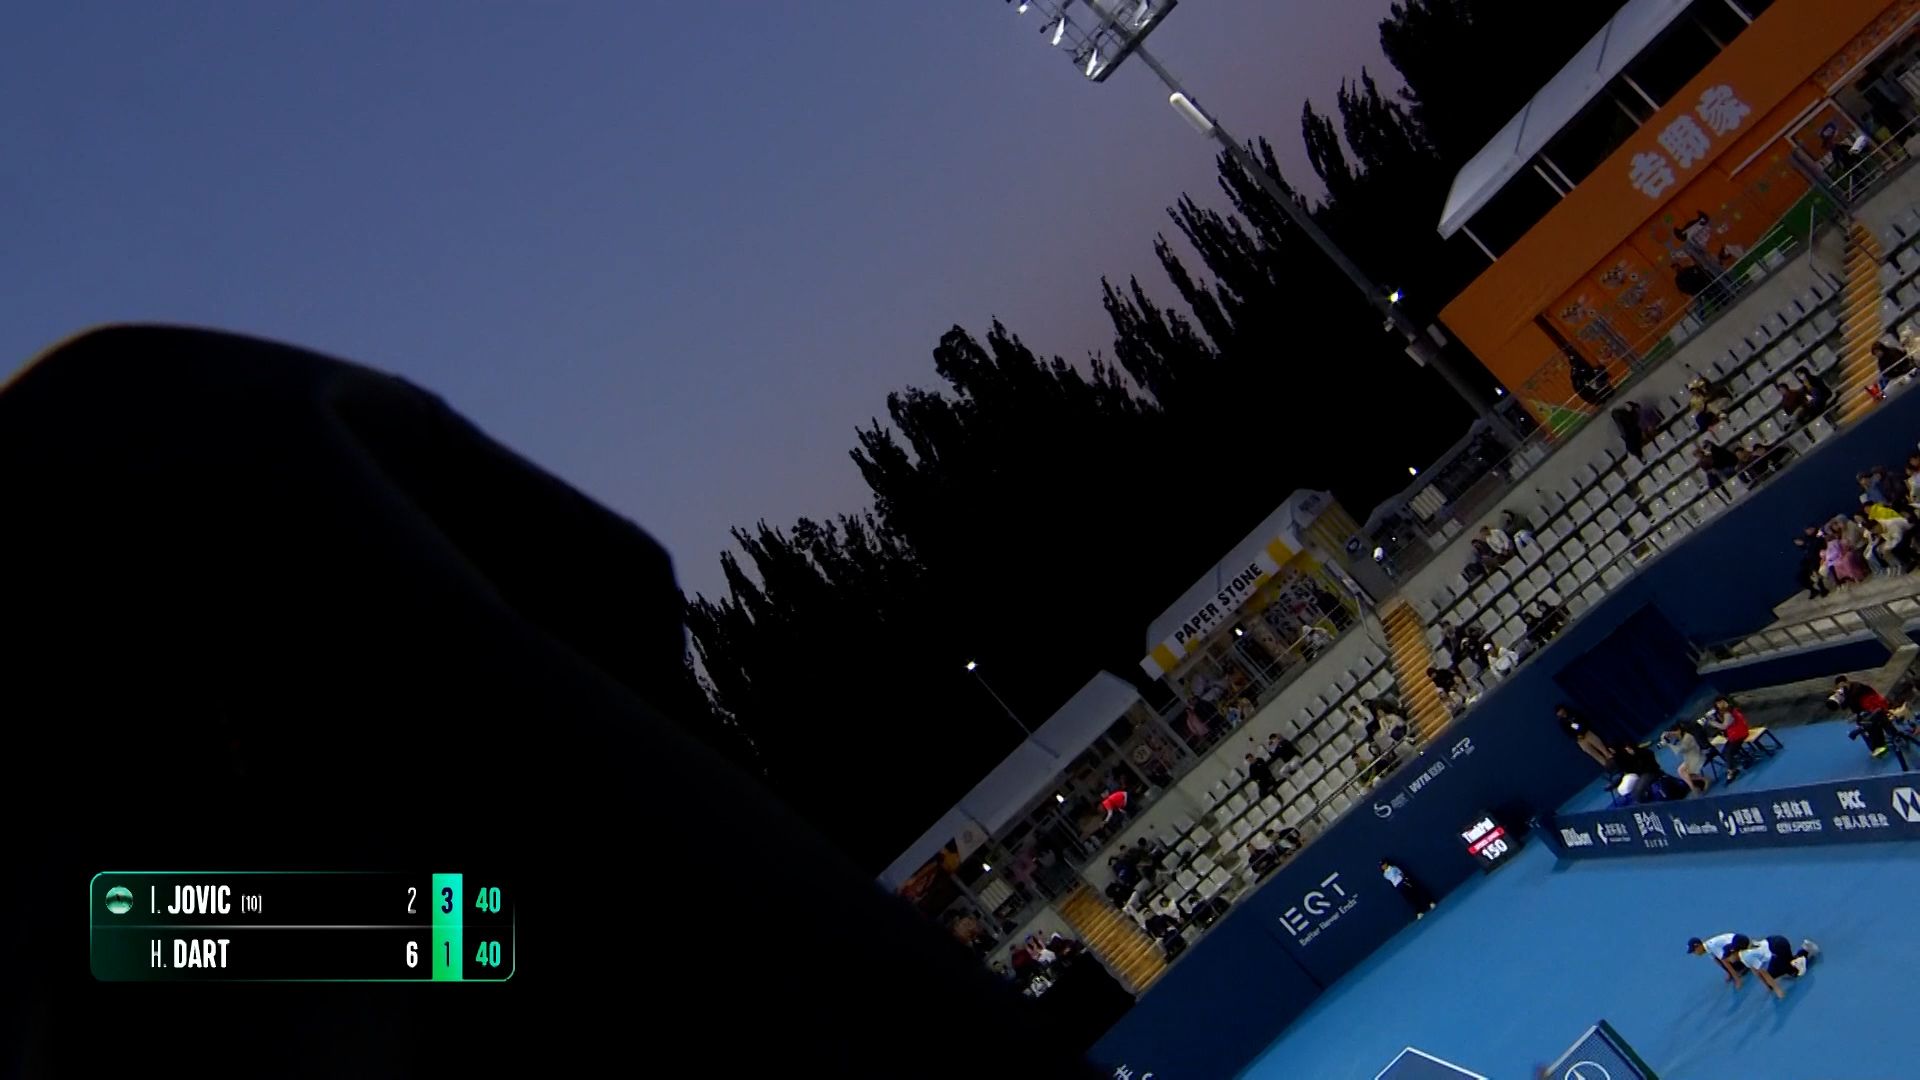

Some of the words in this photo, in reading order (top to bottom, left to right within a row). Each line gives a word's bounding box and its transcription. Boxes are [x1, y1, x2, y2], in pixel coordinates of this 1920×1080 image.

[1175, 603, 1219, 644] PAPER
[1218, 563, 1262, 606] STONE
[1482, 839, 1508, 860] 150
[1279, 871, 1345, 936] EQT
